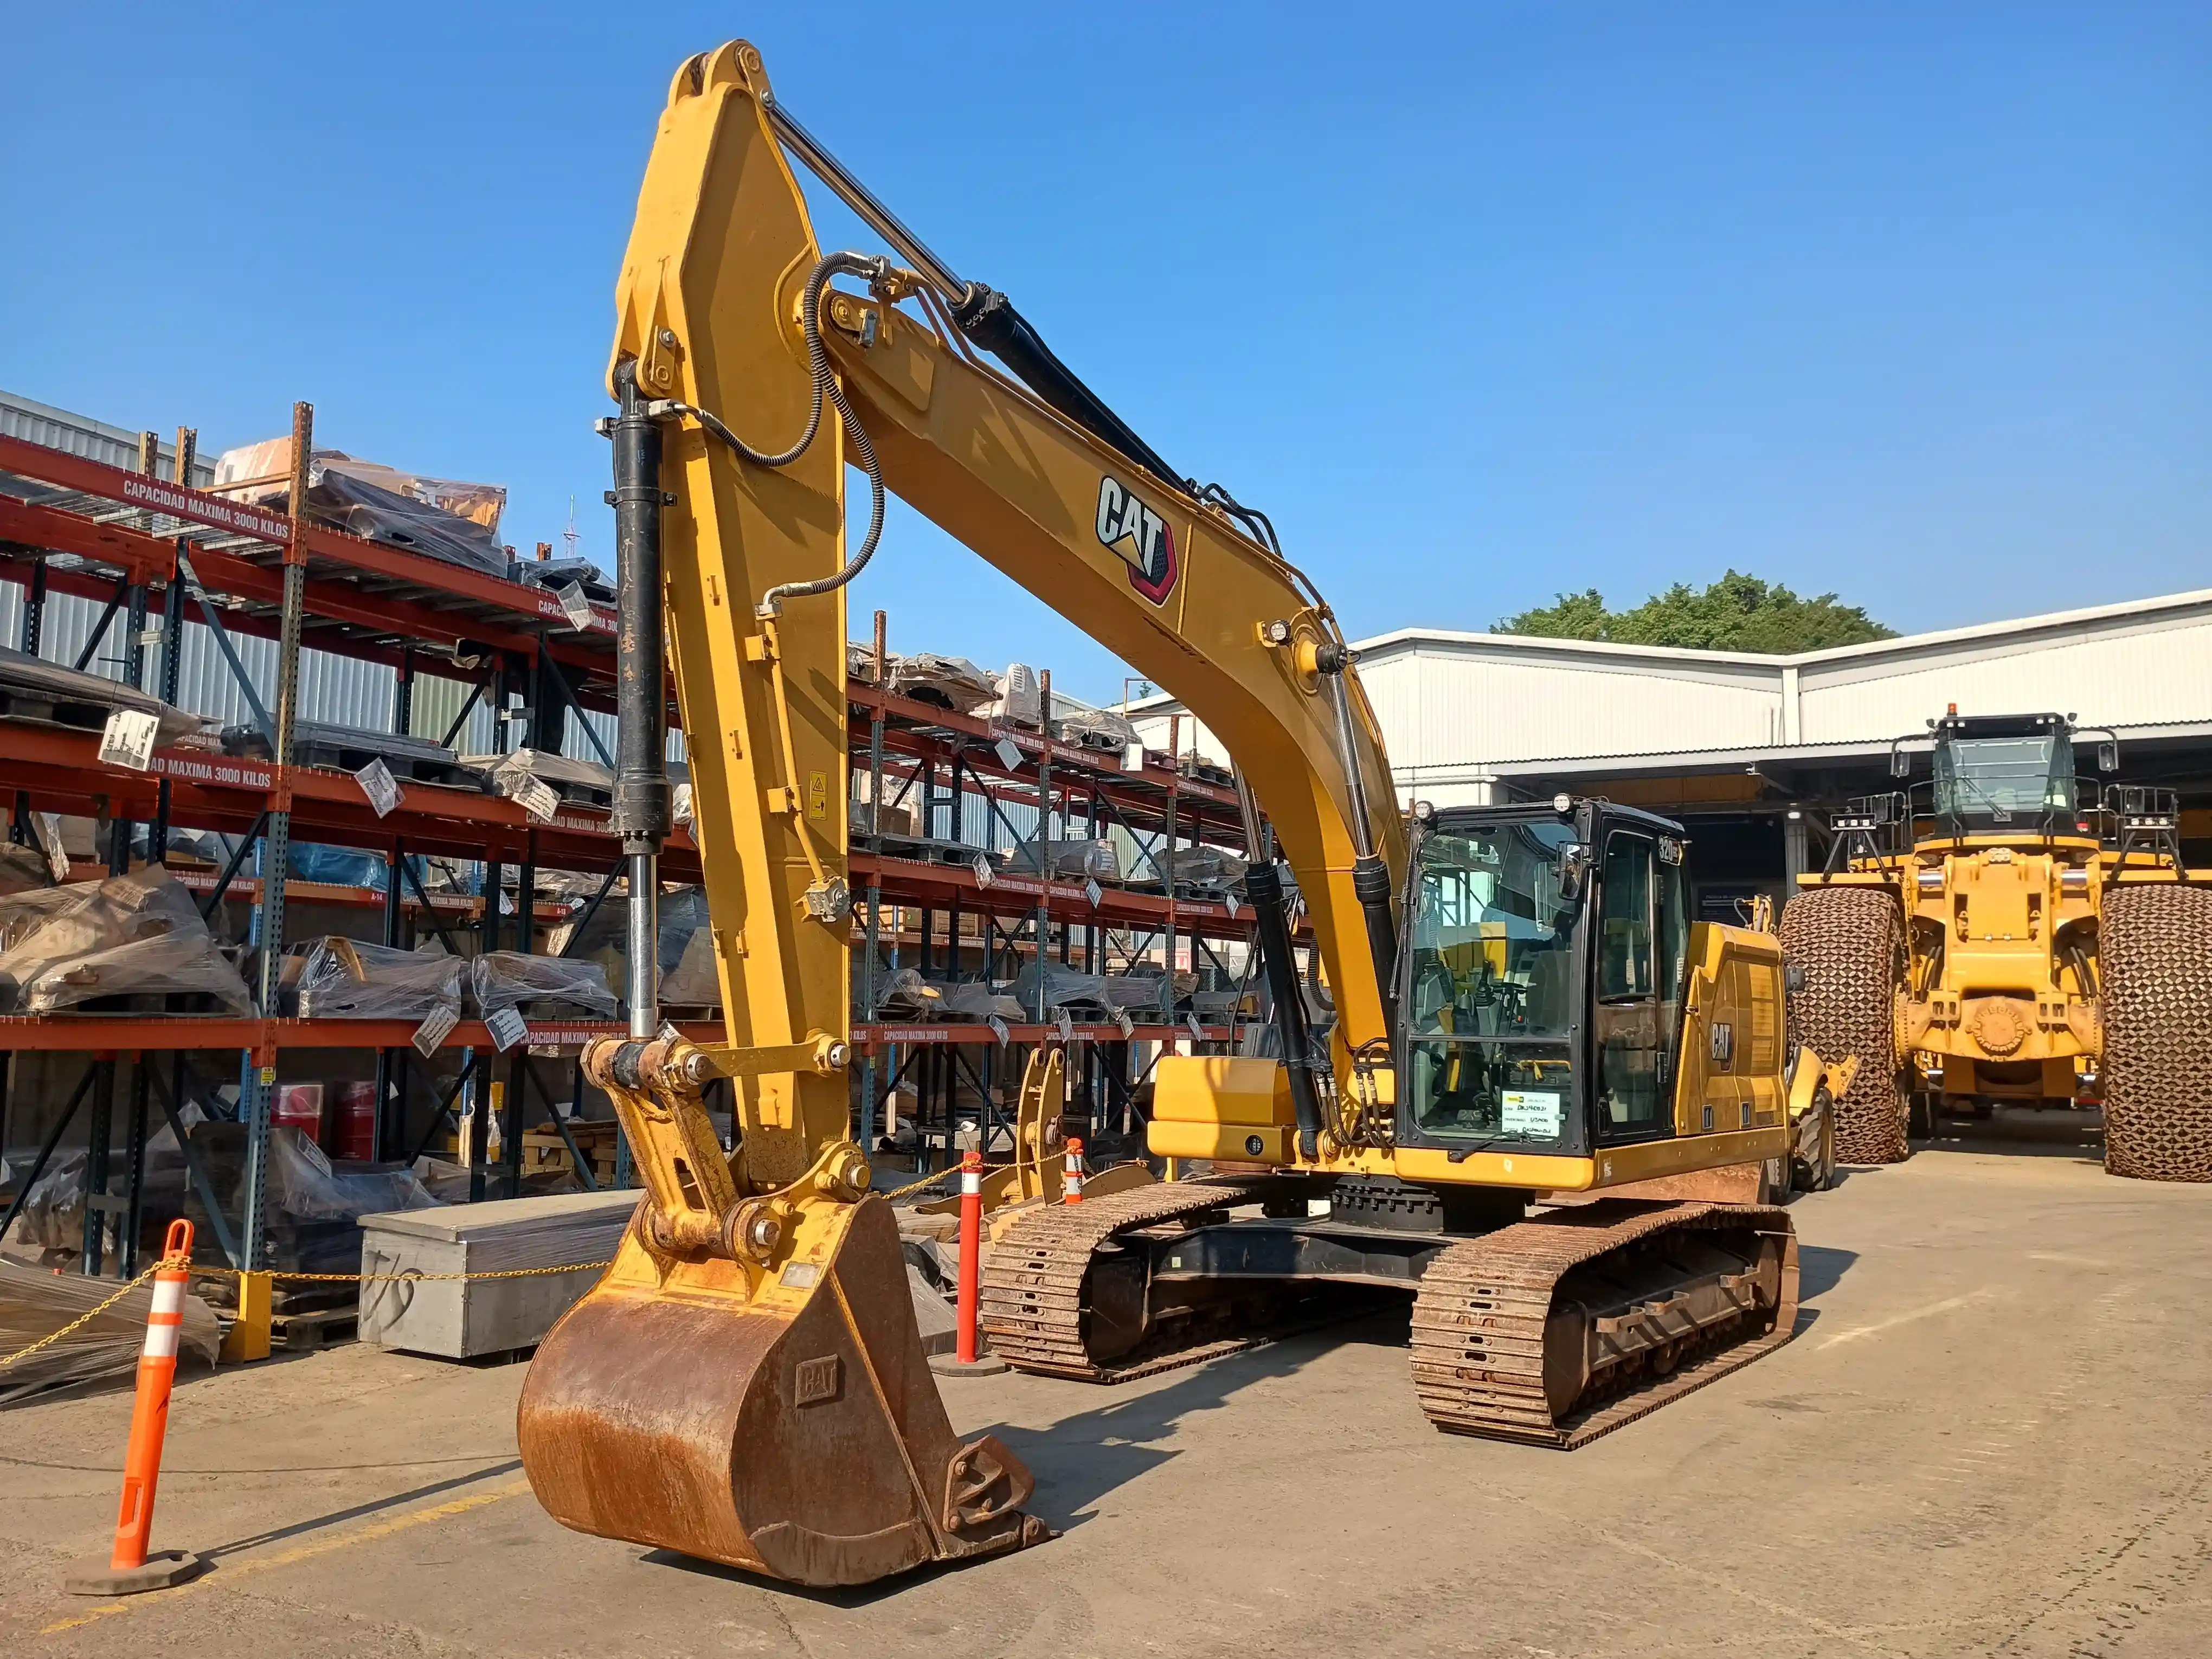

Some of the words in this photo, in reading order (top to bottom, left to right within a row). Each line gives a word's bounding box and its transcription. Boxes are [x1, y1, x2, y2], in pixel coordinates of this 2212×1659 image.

[124, 480, 185, 510] CAPACIDAD
[188, 498, 231, 523] MAXIMA
[234, 512, 258, 530] 3000
[261, 520, 288, 538] KILOS
[1098, 478, 1162, 576] CAT
[177, 735, 206, 745] APACIDAD
[169, 762, 212, 780] MAXIMA
[215, 767, 240, 783] 3000
[242, 770, 270, 787] KILOS
[567, 817, 594, 832] MAXIMA
[1658, 838, 1673, 861] 320
[238, 881, 255, 890] KILOS
[520, 1032, 560, 1044] CAPACIDAD
[561, 1032, 589, 1044] MAXIMA
[853, 1031, 866, 1040] KILOS
[884, 1030, 907, 1040] CAPACIDAD
[1712, 1023, 1730, 1059] CAT
[800, 1361, 837, 1399] CAT
